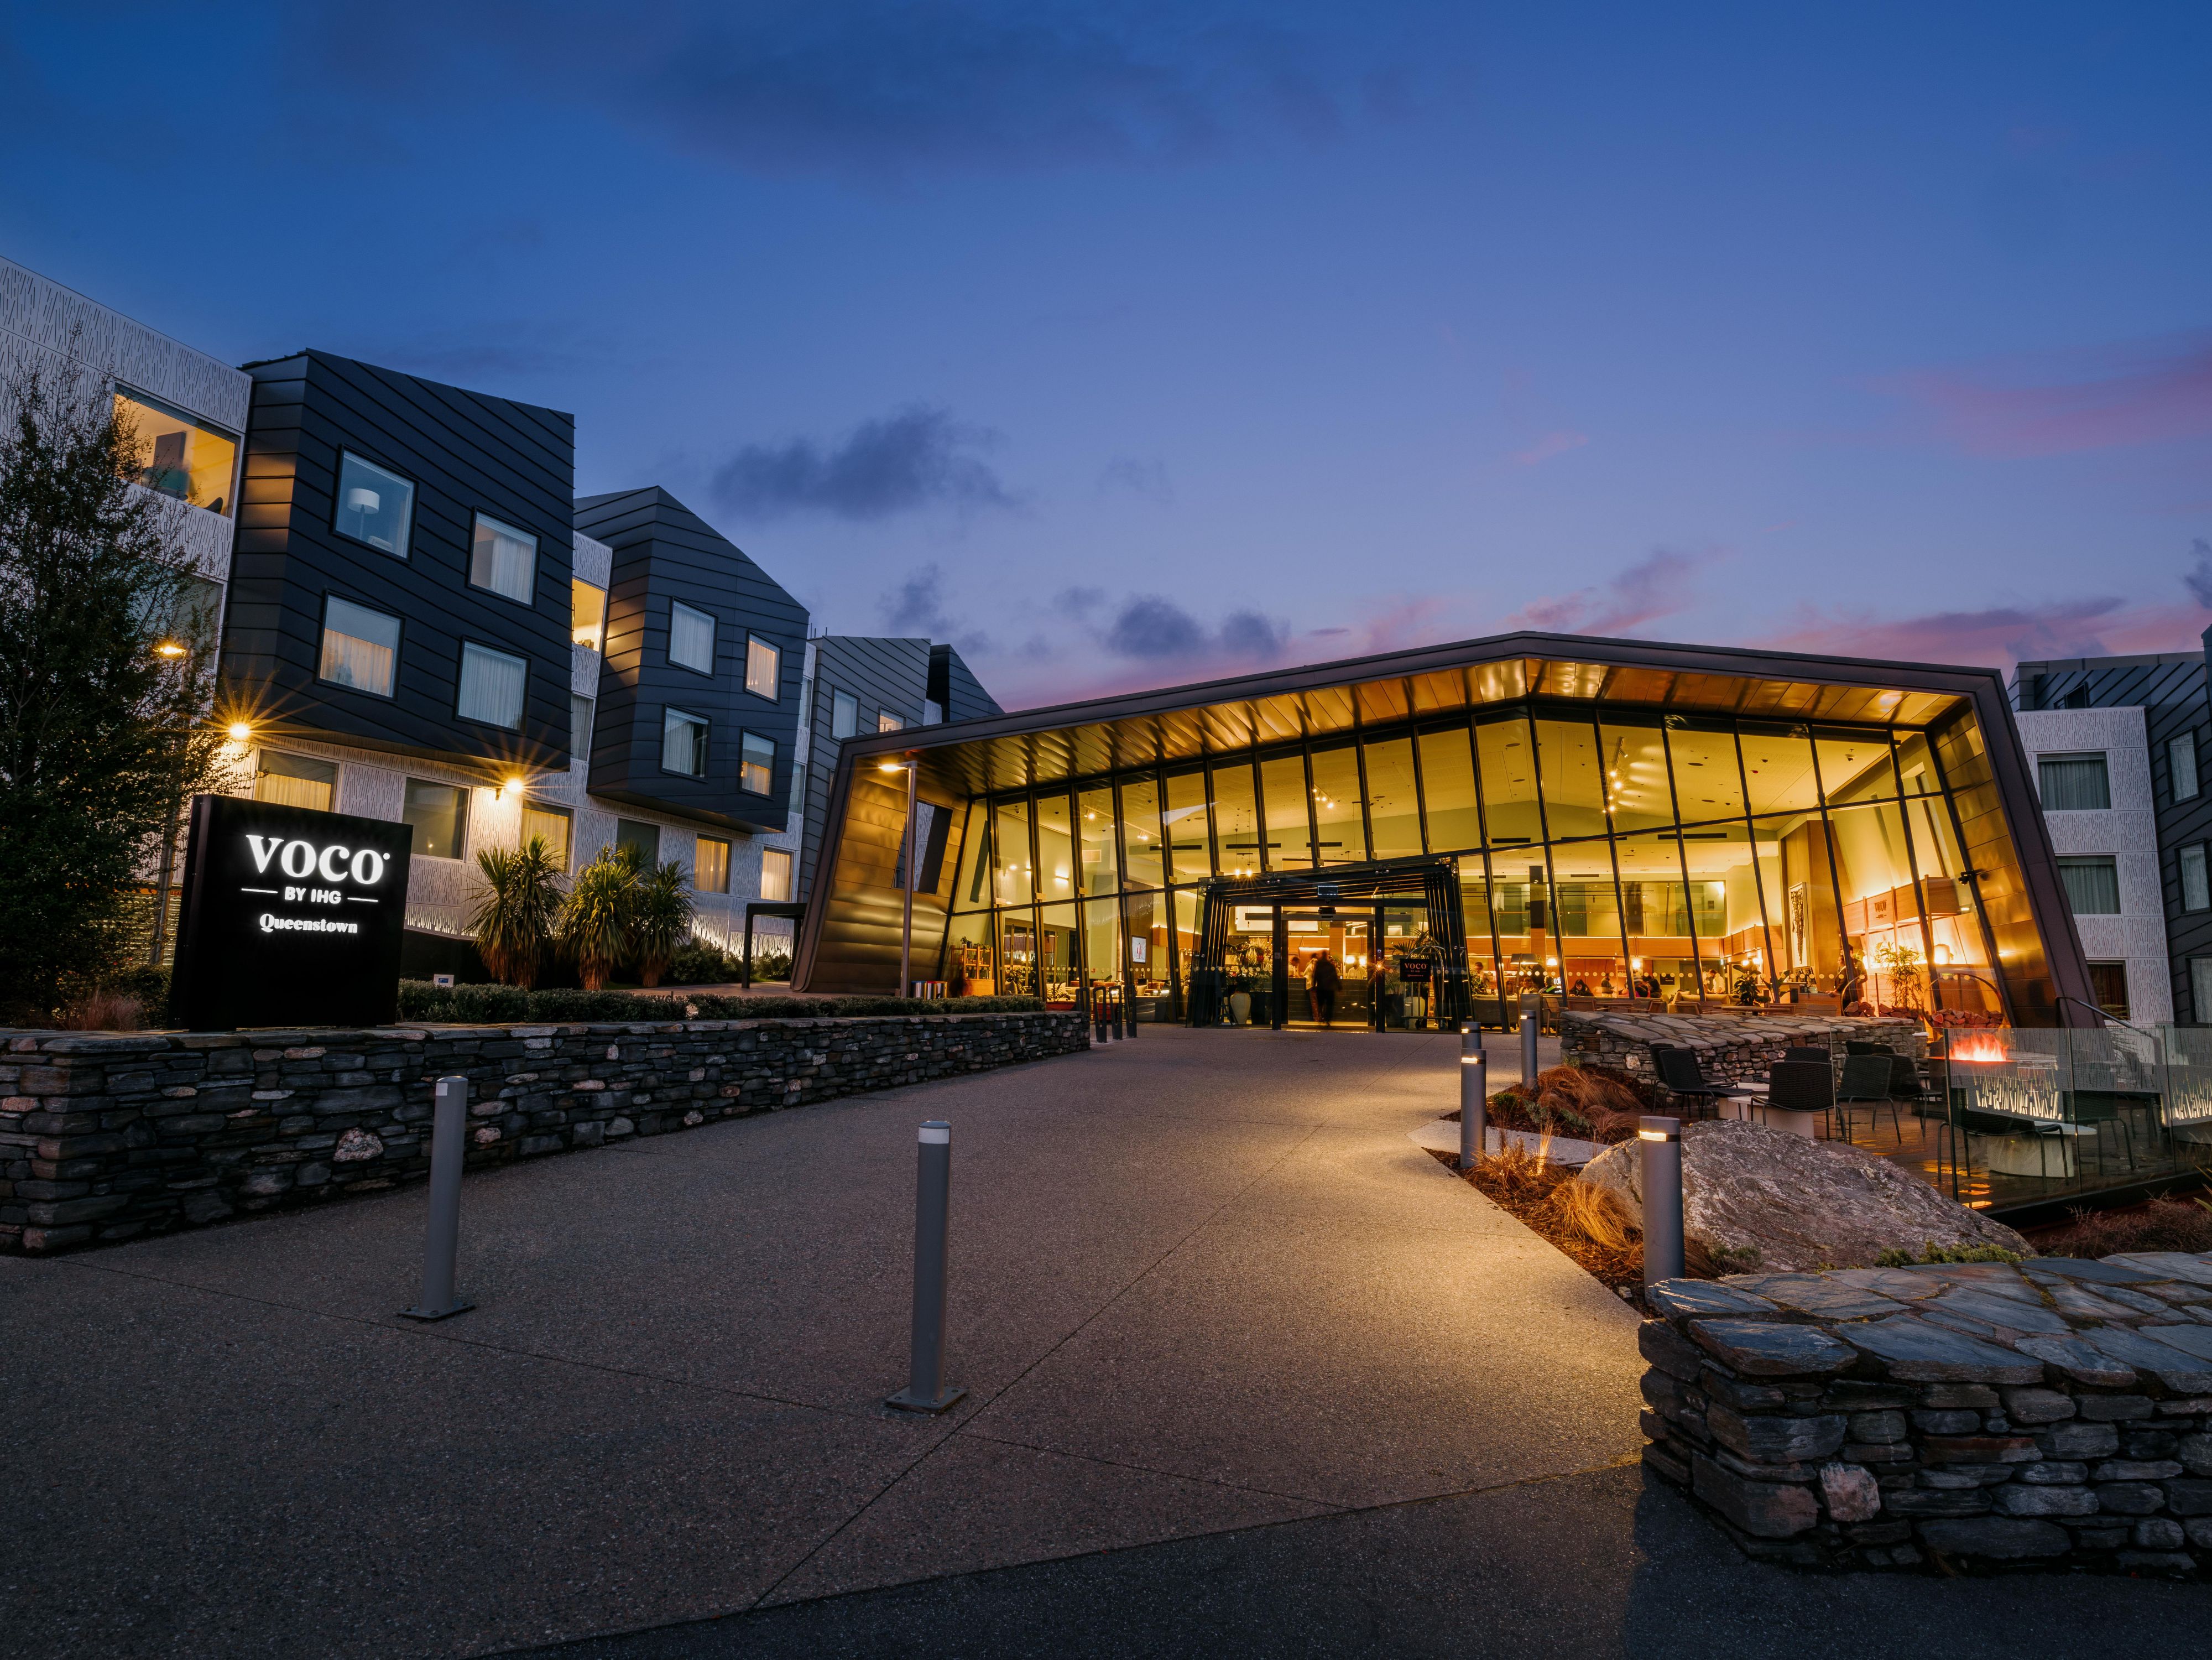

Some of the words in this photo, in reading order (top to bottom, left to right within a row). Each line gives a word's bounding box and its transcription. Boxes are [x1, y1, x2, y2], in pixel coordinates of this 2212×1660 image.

[284, 886, 306, 901] BY
[310, 888, 341, 904] IHG
[259, 913, 358, 933] Queenstown
